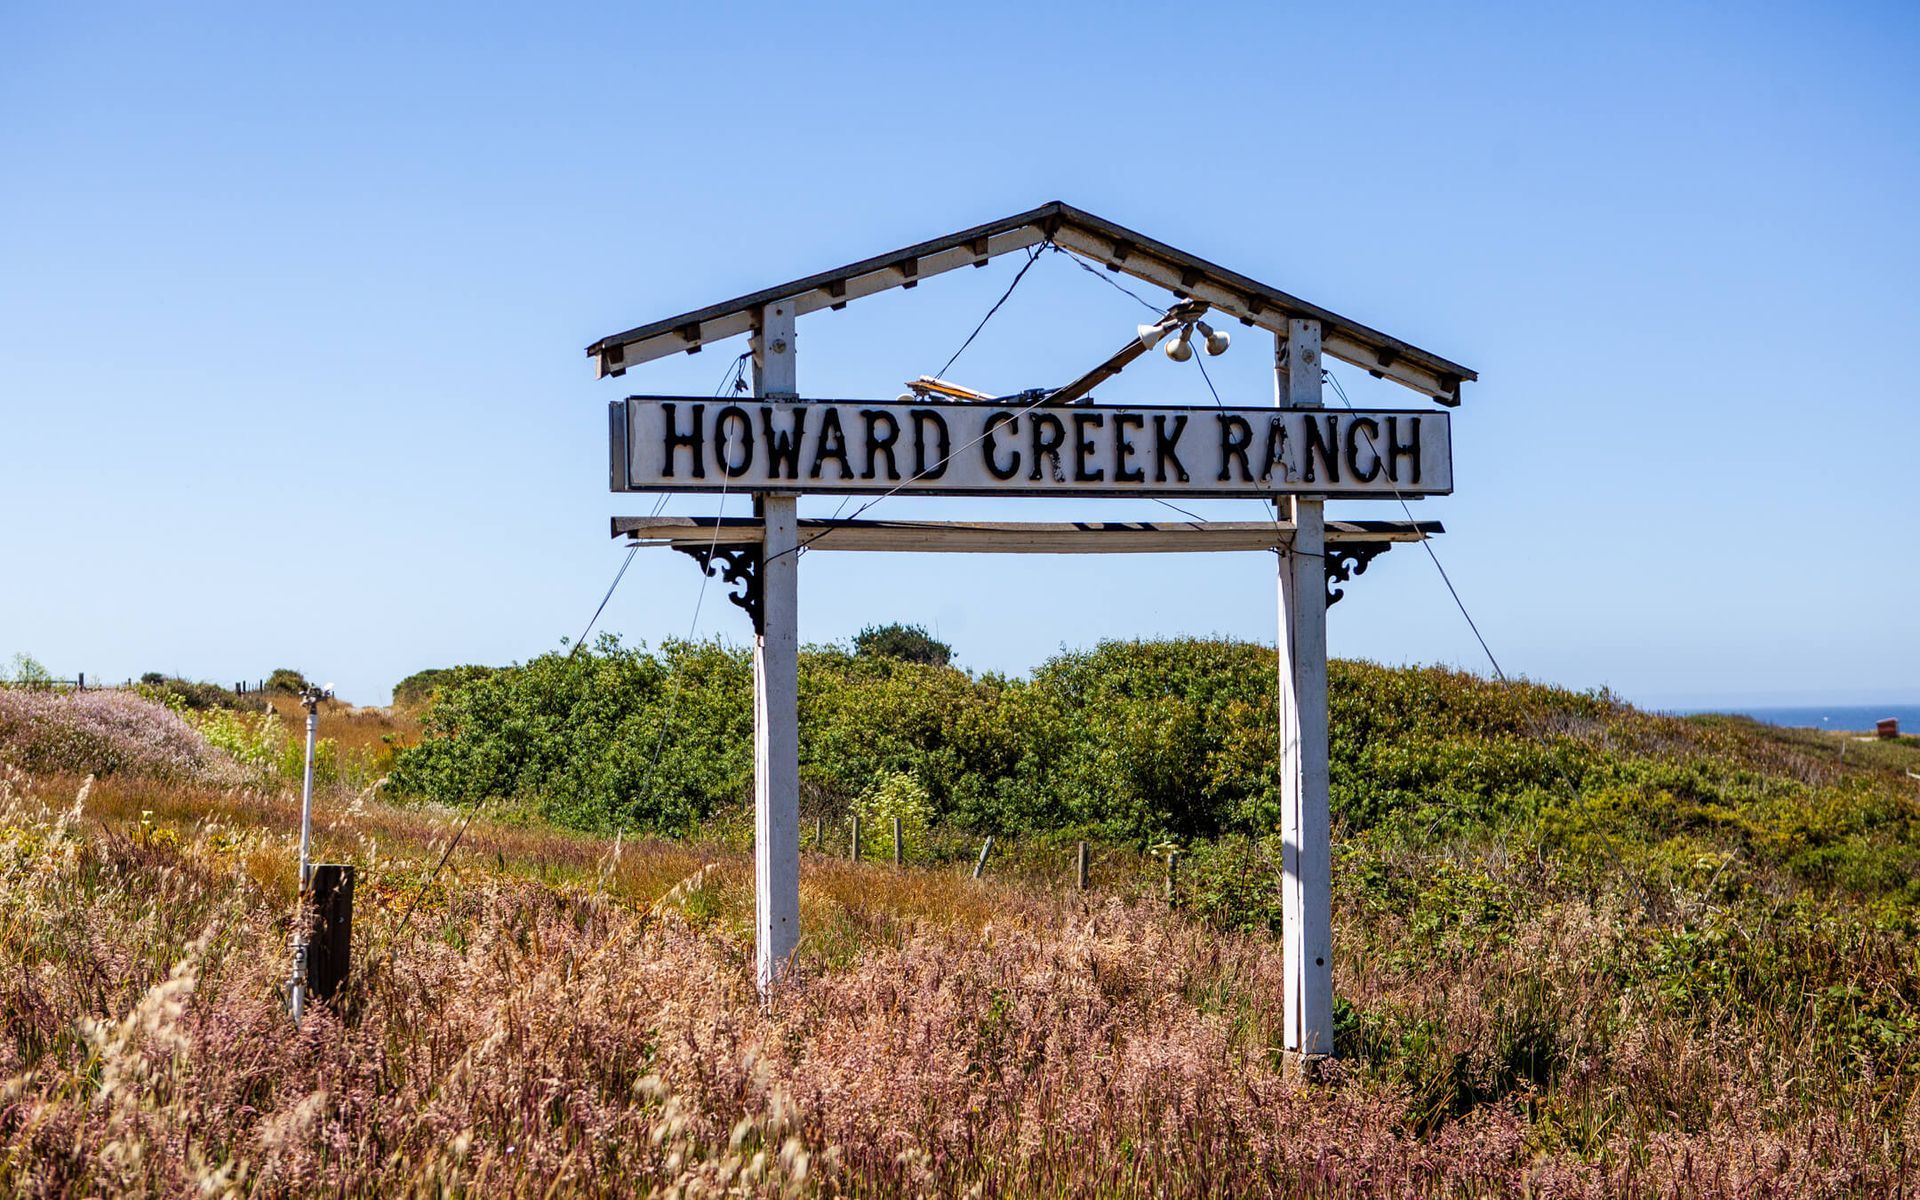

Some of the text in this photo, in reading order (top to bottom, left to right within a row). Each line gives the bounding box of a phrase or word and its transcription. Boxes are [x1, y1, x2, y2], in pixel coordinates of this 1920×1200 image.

[661, 402, 1422, 485] HOWARD CREEK RANCH
